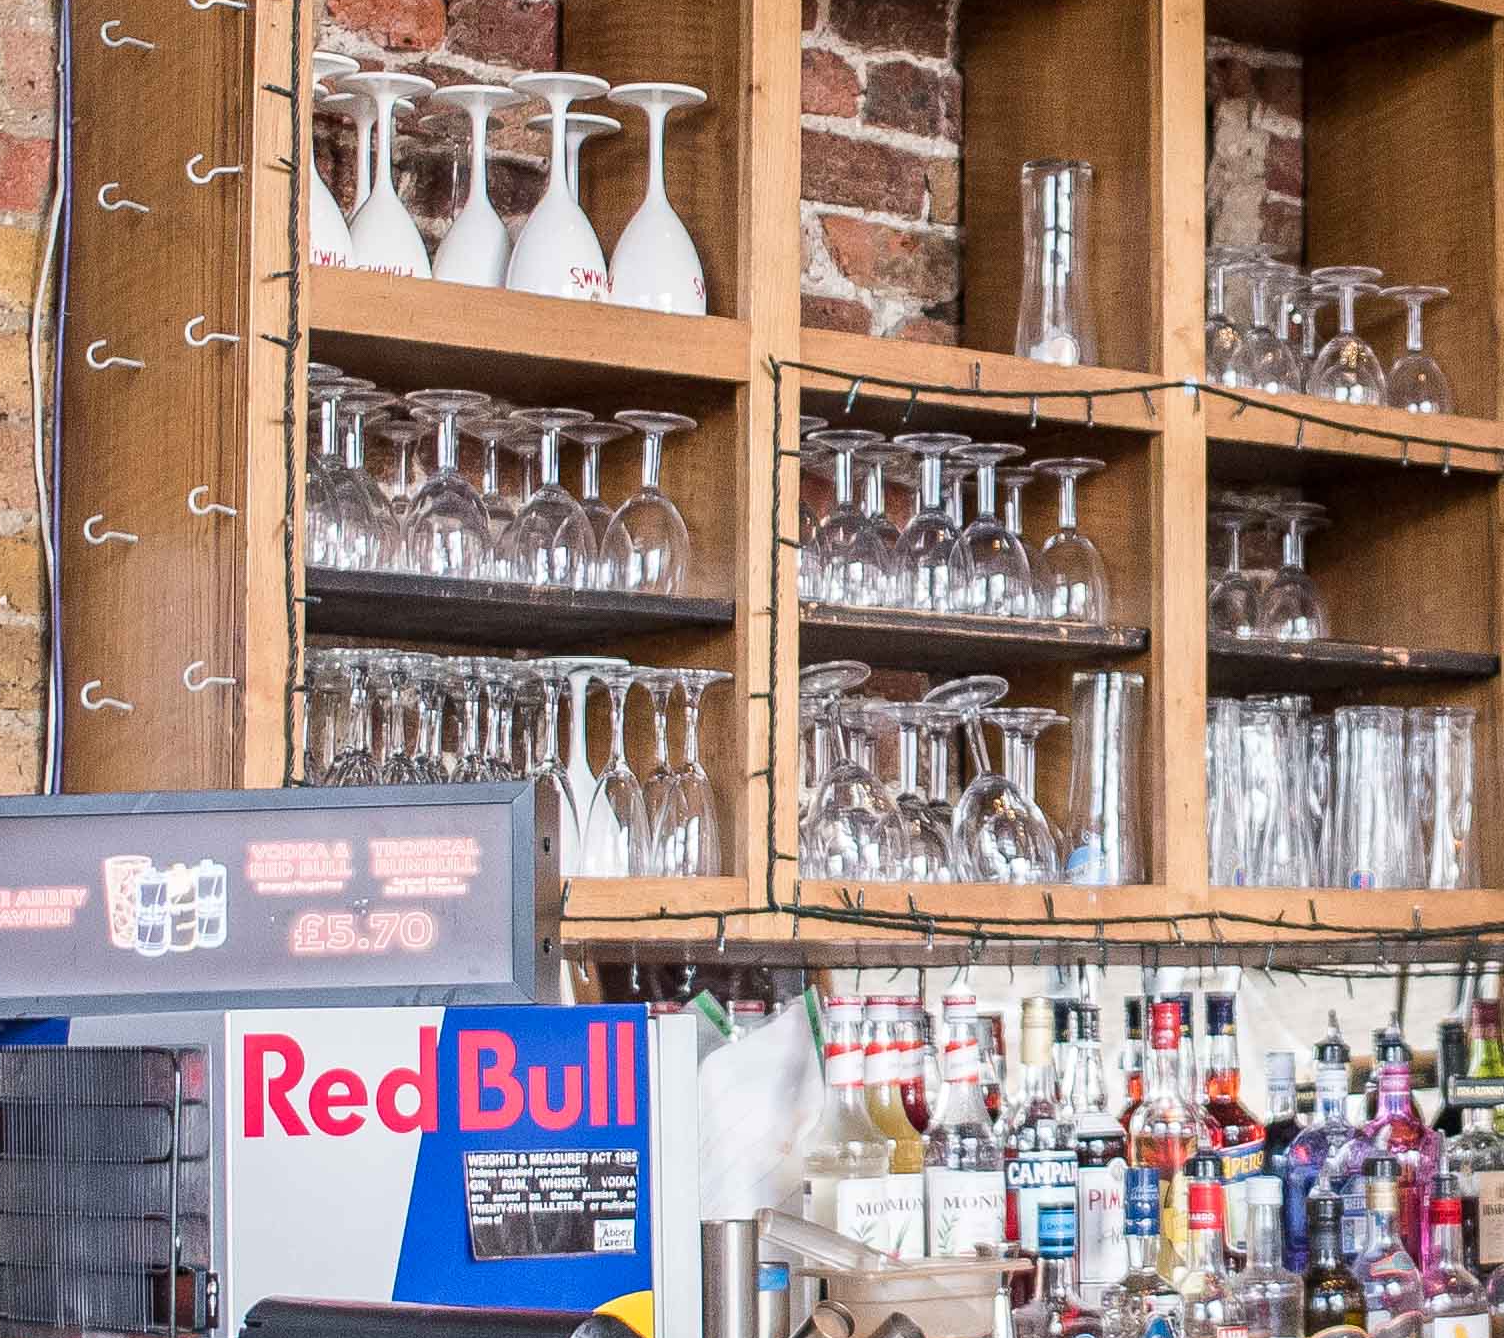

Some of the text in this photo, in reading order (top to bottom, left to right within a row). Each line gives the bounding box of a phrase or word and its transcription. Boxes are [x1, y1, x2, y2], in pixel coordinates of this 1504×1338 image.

[16, 888, 88, 907] ABBEY
[295, 911, 434, 951] £5.70
[241, 1019, 638, 1139] Red Bull
[468, 1153, 517, 1167] WEIGHTS
[518, 1153, 527, 1166] &
[529, 1152, 589, 1166] MEASURES
[591, 1151, 612, 1164] ACT
[501, 1178, 529, 1192] RUM,
[539, 1176, 591, 1191] WHISKEY,
[601, 1176, 636, 1188] VODKA
